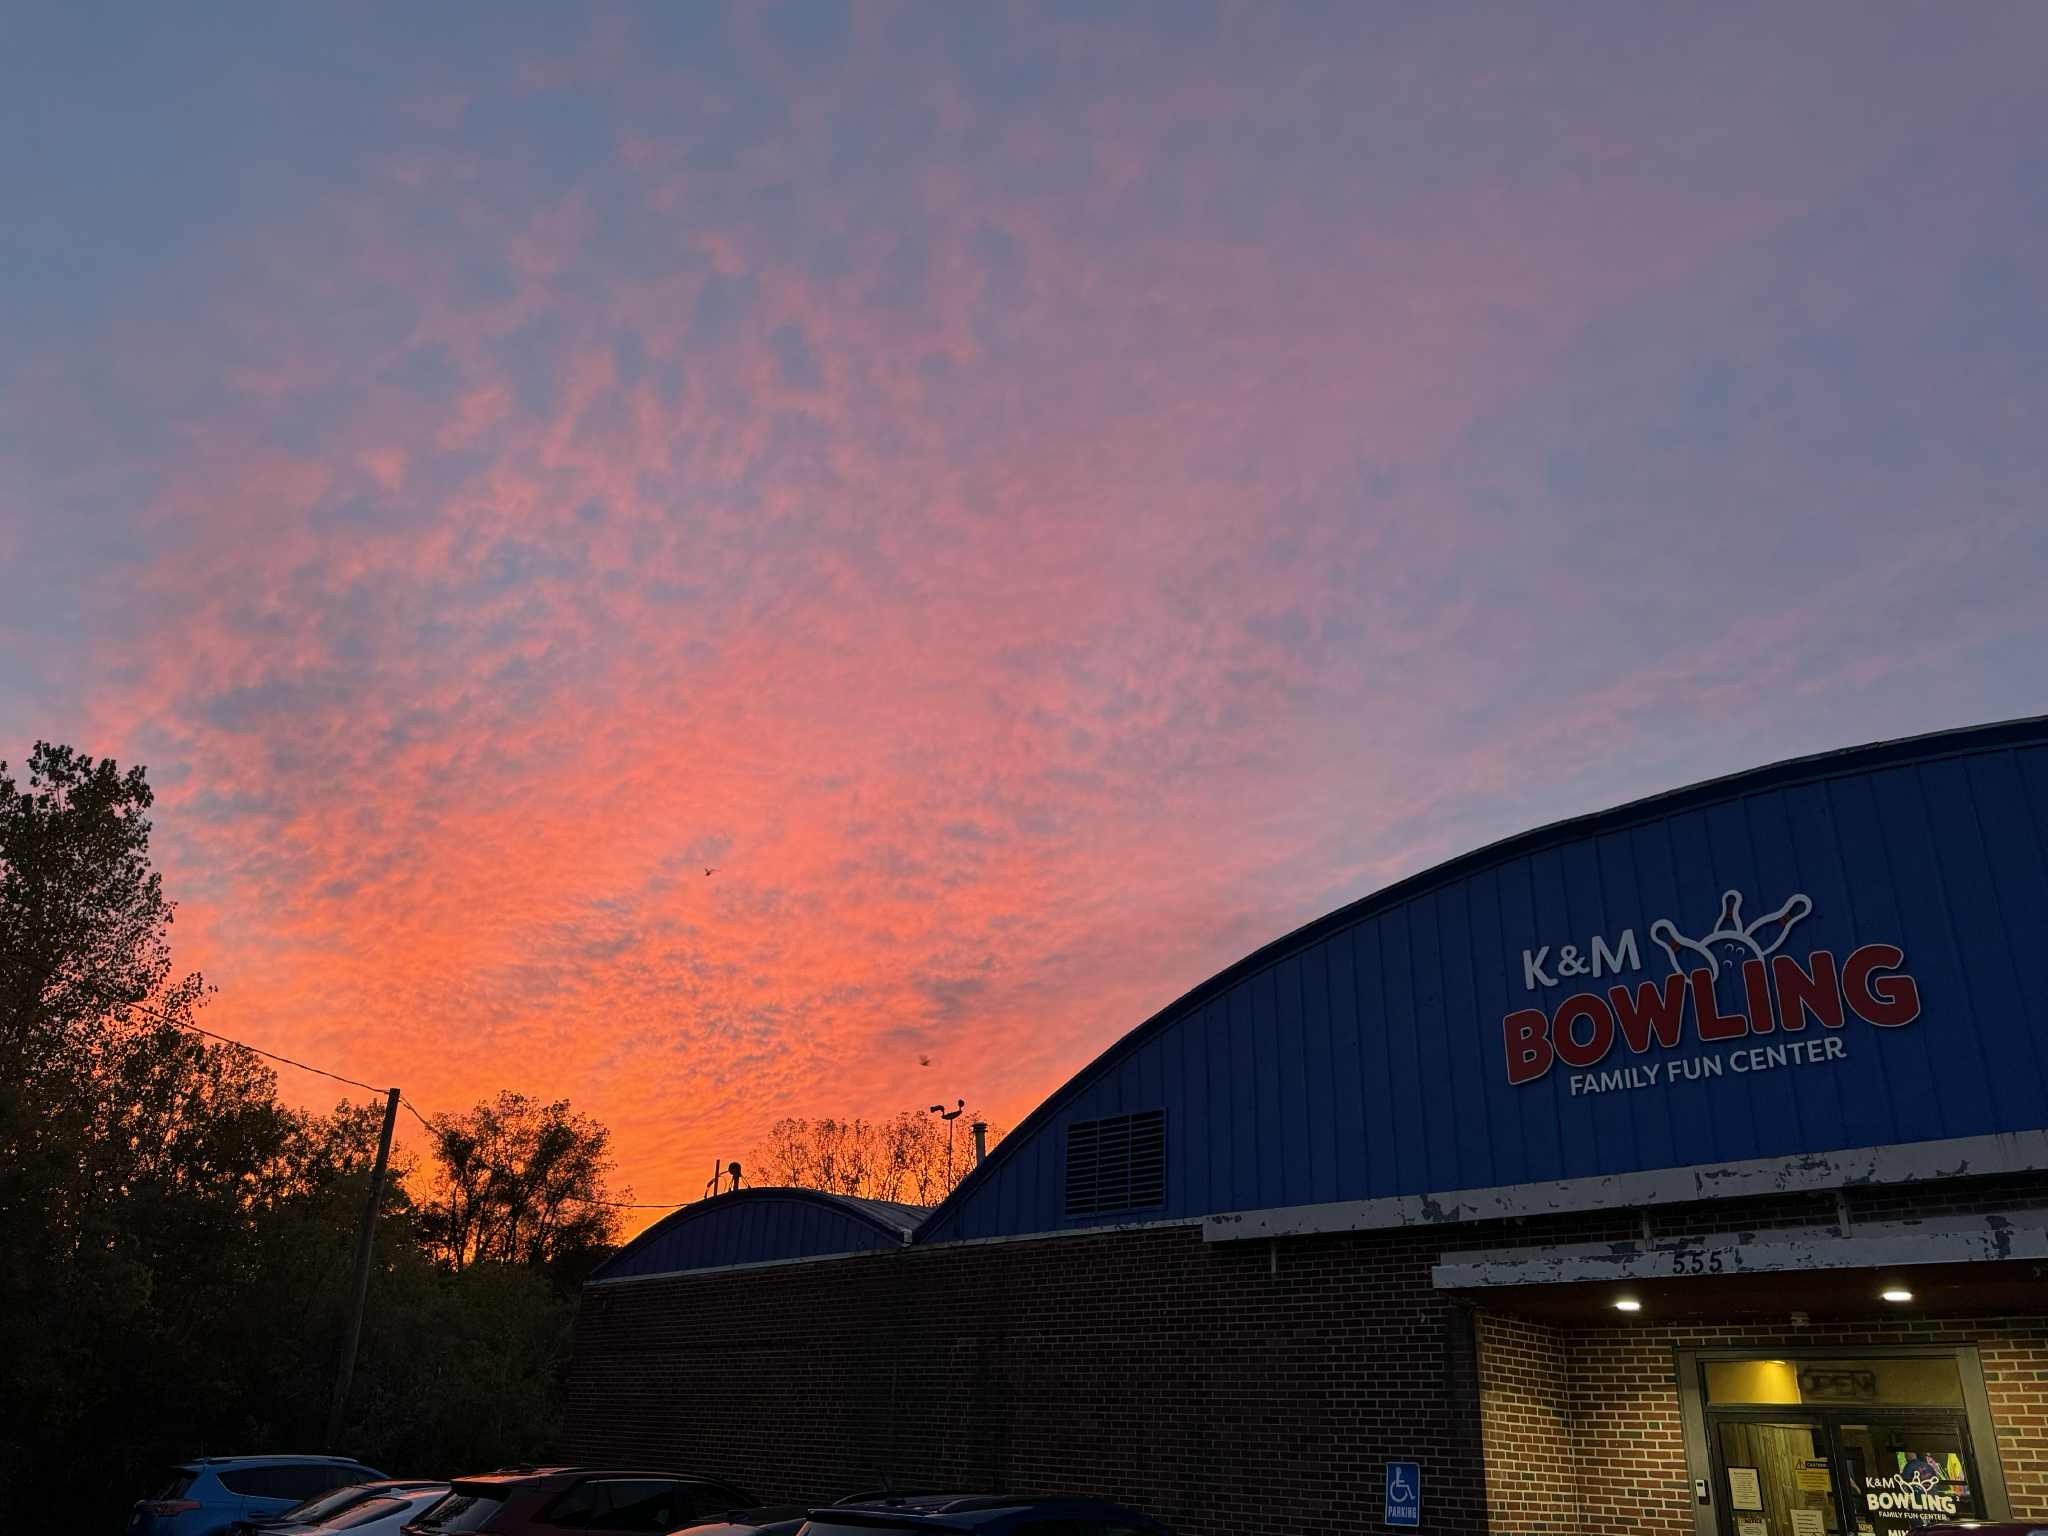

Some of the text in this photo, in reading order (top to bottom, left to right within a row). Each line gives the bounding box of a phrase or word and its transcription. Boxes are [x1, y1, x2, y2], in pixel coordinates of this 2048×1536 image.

[1523, 928, 1641, 990] K&M
[1503, 943, 1921, 1085] BOWLING
[1570, 1036, 1847, 1096] FAMILY FUN CENTER
[1673, 1250, 1722, 1274] 555
[1866, 1477, 1895, 1489] K&M
[1388, 1506, 1417, 1519] PARKING
[1866, 1492, 1957, 1514] BOWLING
[1879, 1511, 1947, 1521] FAMILY FUN CENTER
